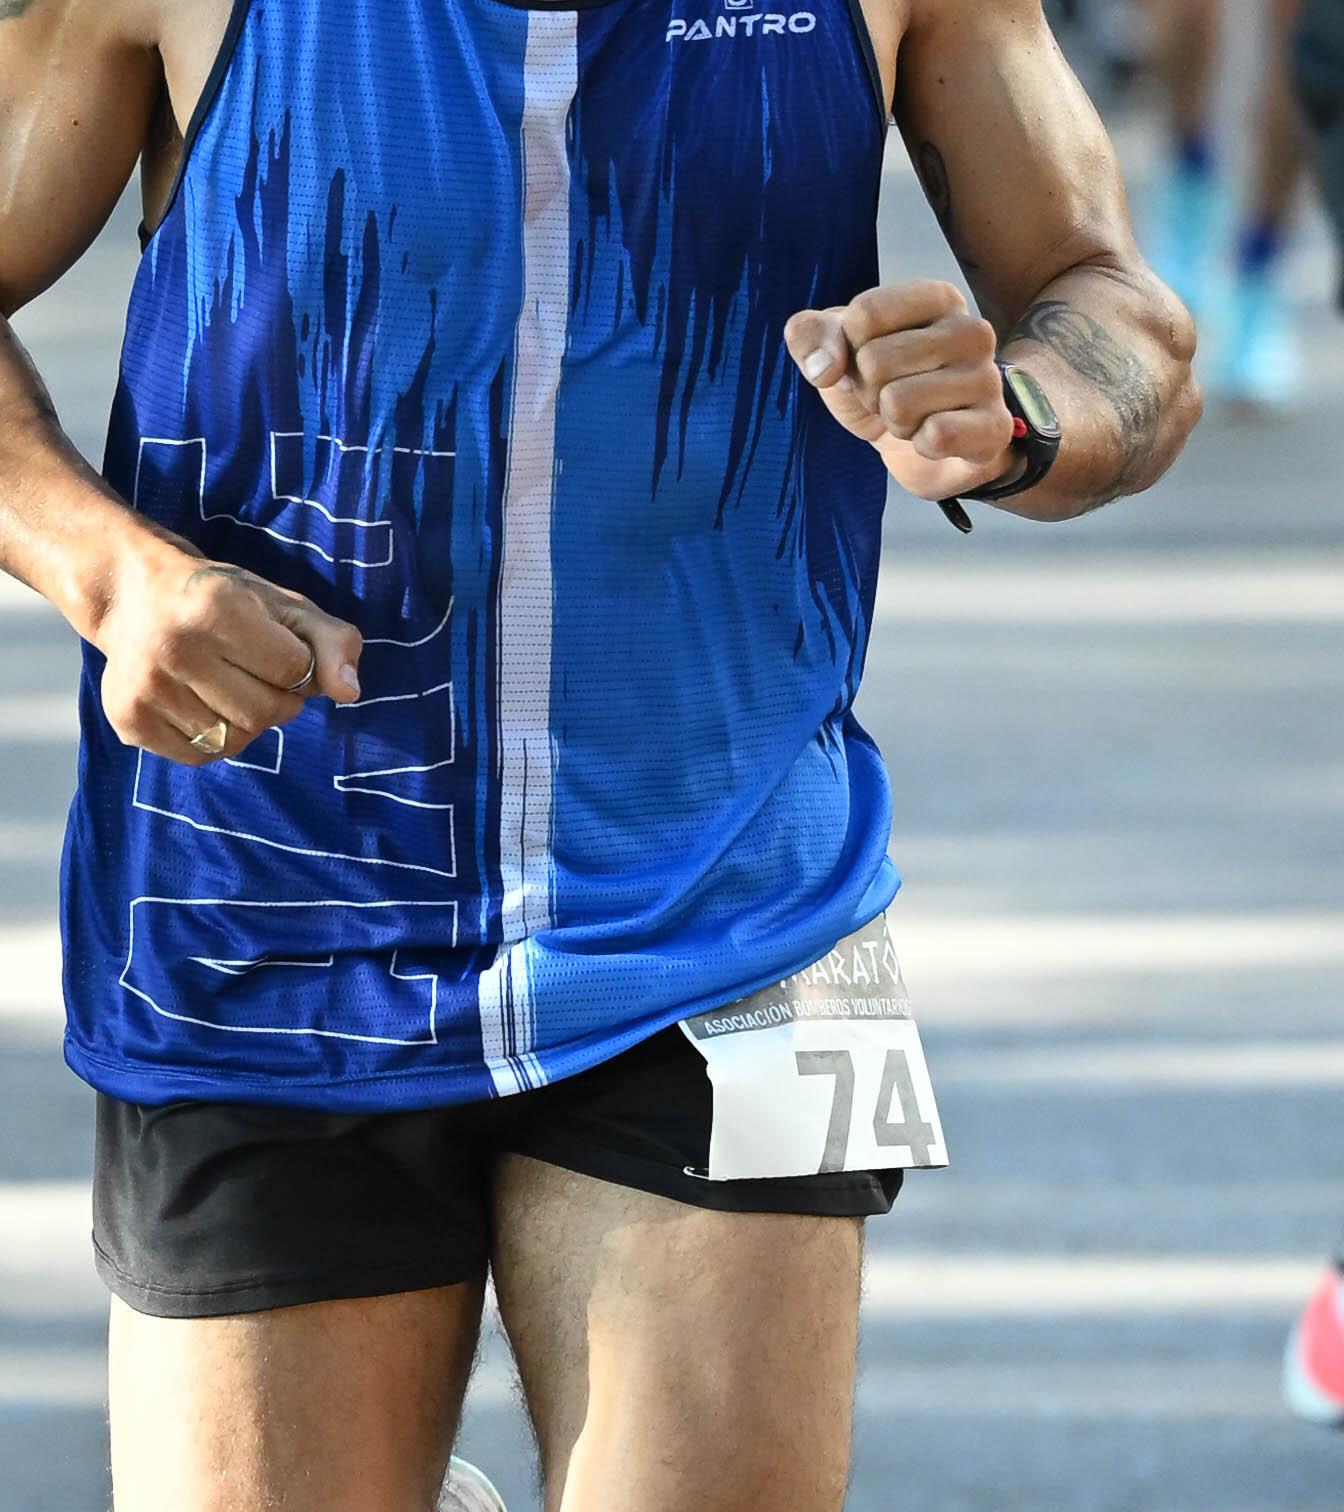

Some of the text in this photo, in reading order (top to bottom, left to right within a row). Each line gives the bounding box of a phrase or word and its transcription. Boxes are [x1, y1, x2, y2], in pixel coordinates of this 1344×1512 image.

[665, 11, 816, 43] PANTRO
[780, 926, 905, 988] ARATÓ
[704, 1002, 793, 1035] ASOCIACIÓN
[792, 998, 850, 1017] BOMBEROS
[795, 1049, 936, 1173] 74
